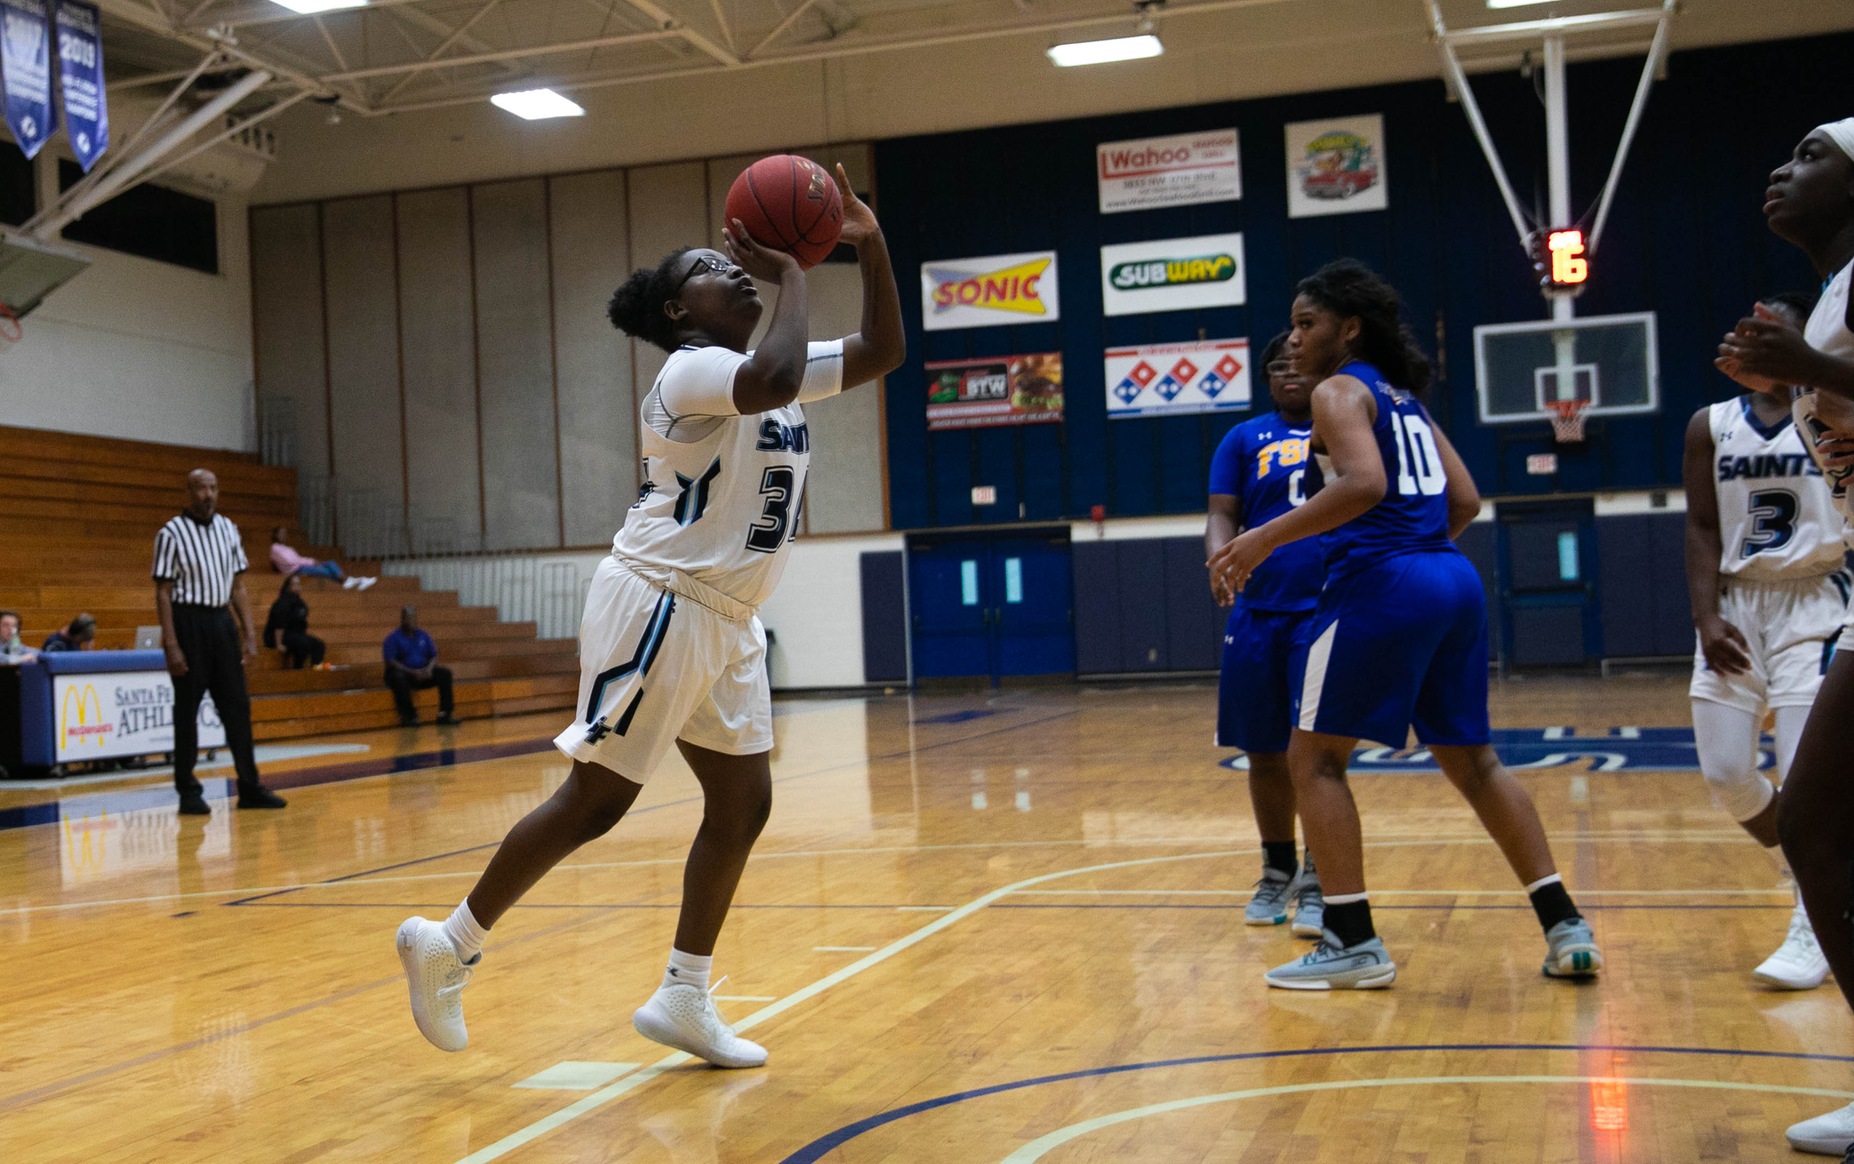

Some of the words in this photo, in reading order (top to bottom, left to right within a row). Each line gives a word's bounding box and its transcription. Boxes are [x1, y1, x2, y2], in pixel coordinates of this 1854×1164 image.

[1111, 147, 1190, 169] Wahoo
[936, 273, 1041, 307] SONIC
[1114, 256, 1232, 286] SUBWAY
[1390, 411, 1447, 495] 10
[745, 465, 809, 553] 3
[1740, 488, 1800, 560] 3
